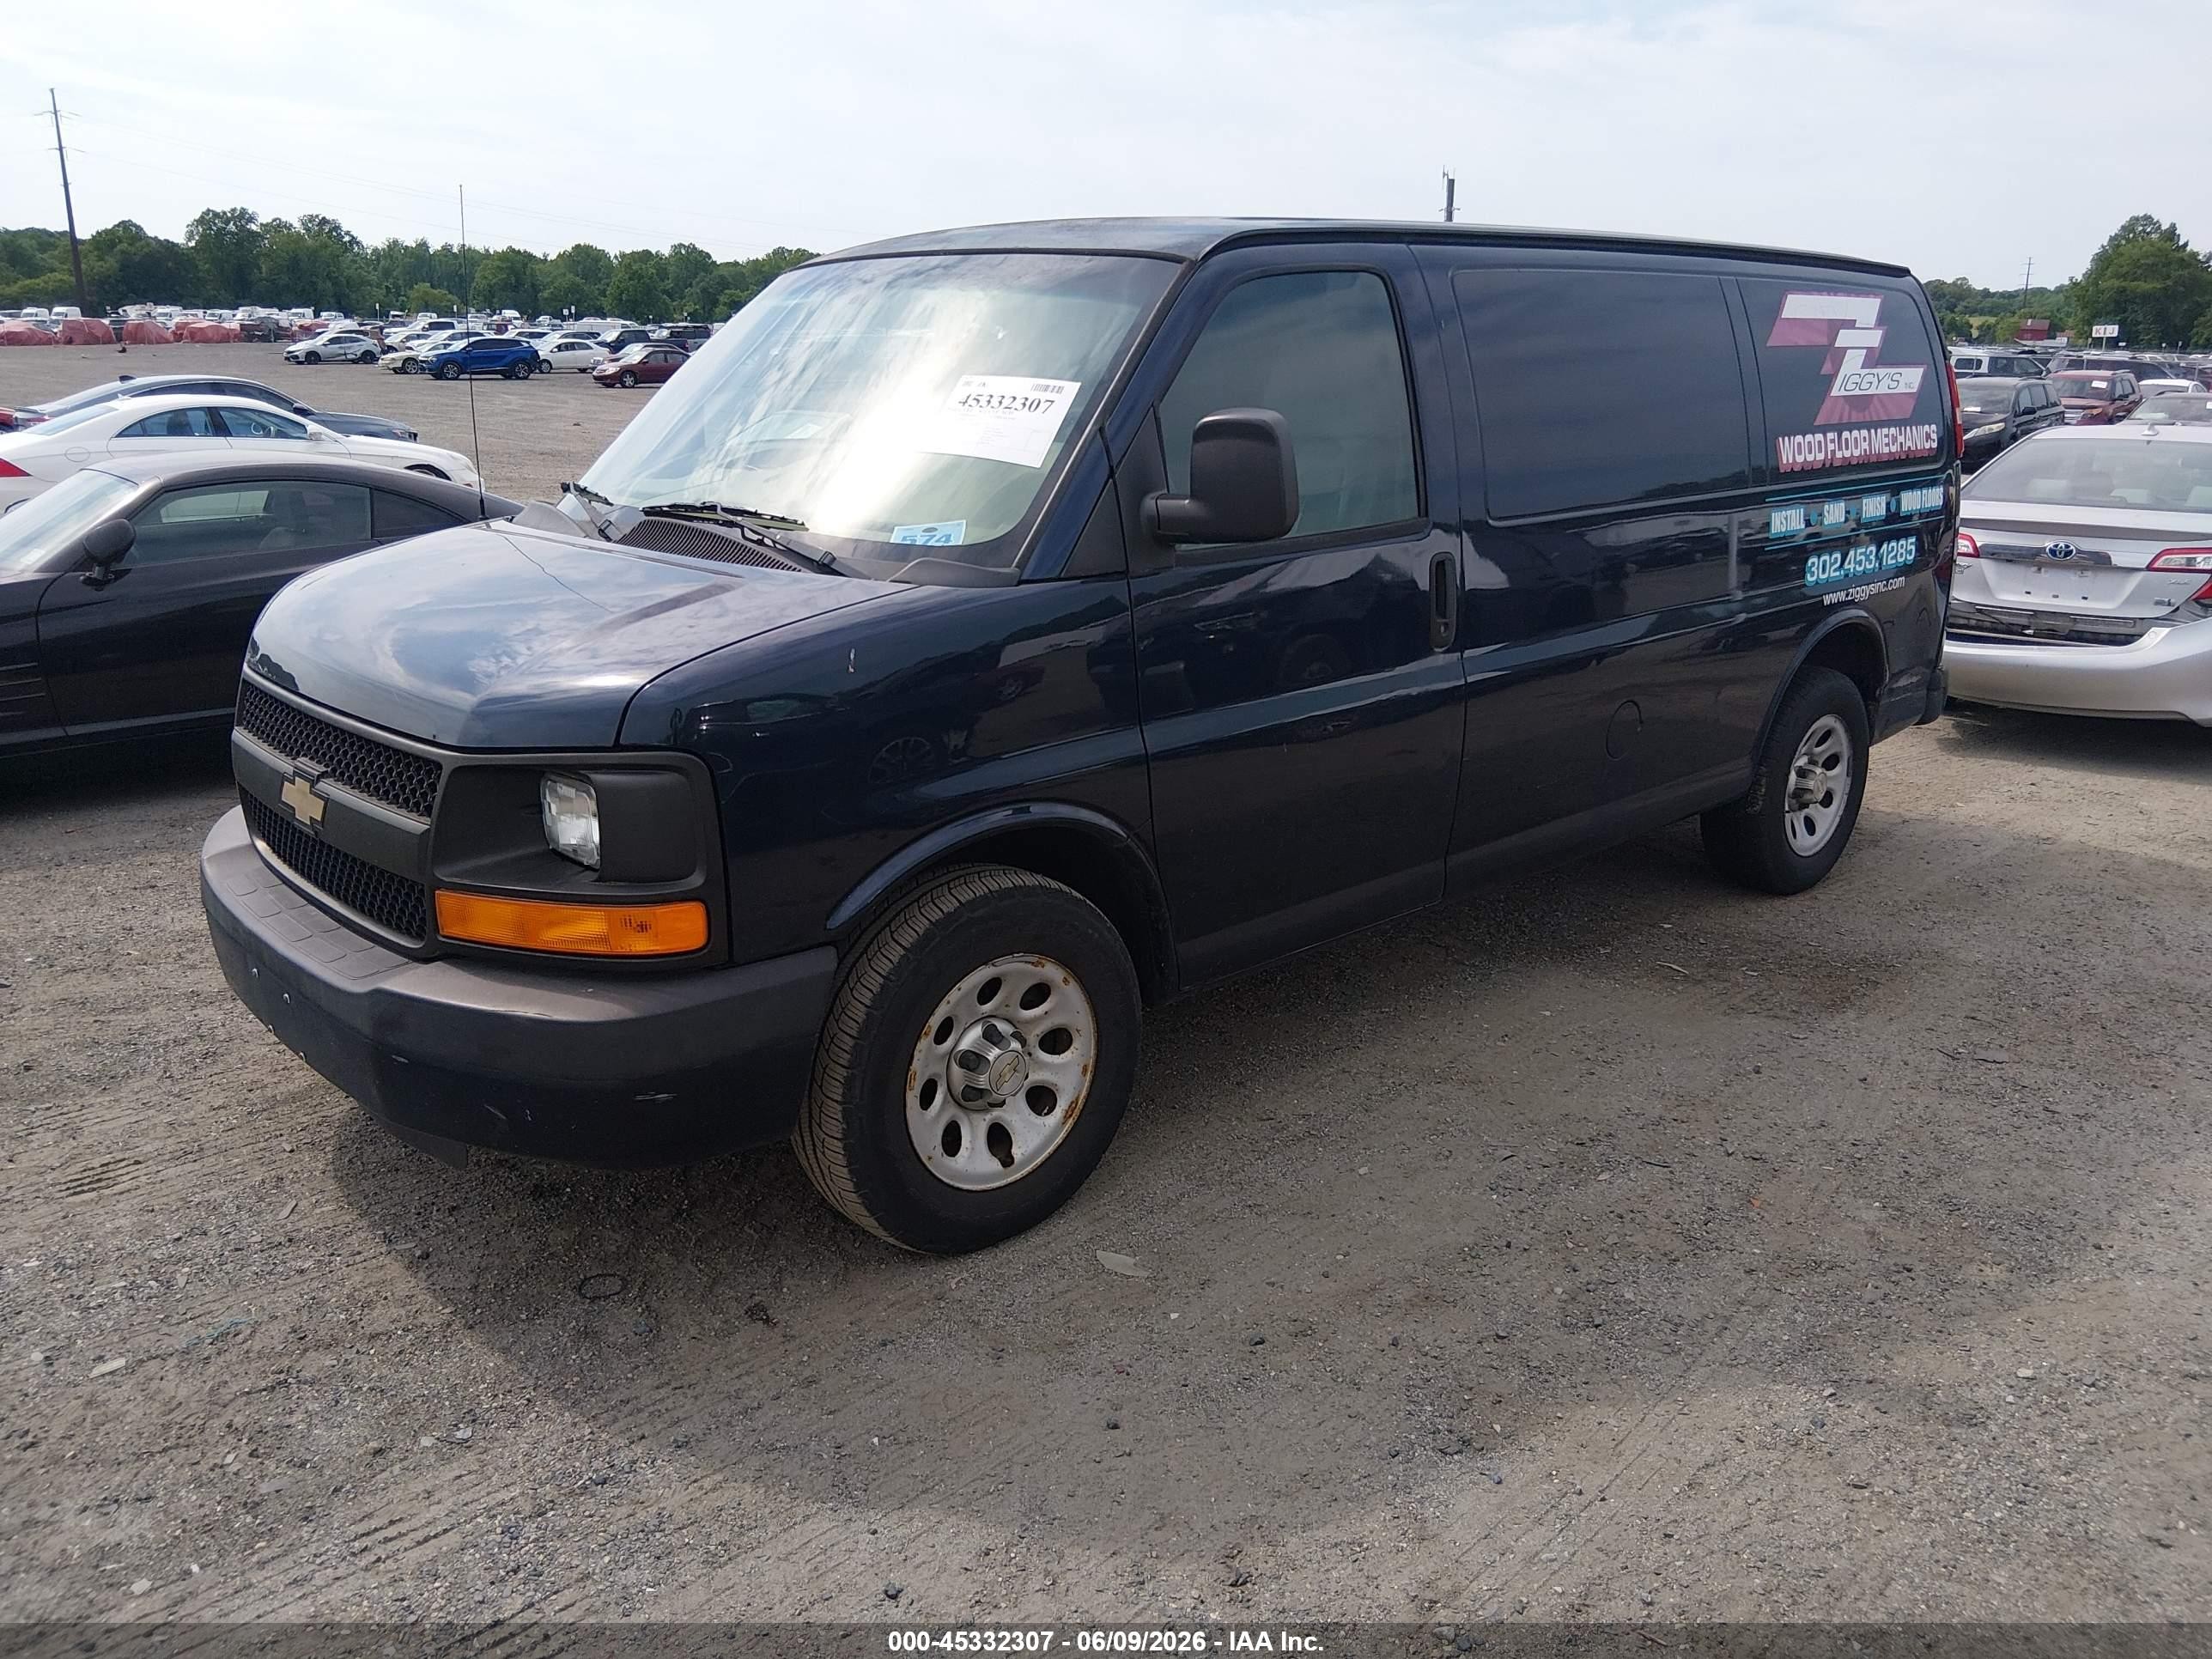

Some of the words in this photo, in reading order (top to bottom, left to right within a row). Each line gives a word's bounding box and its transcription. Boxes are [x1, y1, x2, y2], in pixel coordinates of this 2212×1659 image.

[957, 393, 1055, 415] 45332307
[1778, 433, 1825, 465] WOOD
[1826, 428, 1869, 460] FLOOR
[1870, 424, 1938, 455] MECHANICS
[1771, 507, 1805, 534] INSTALL
[1823, 501, 1845, 526] SAND
[1862, 494, 1887, 519] FINISH
[1901, 489, 1921, 512] WOOD
[1921, 485, 1944, 508] FLOORS
[1806, 536, 1917, 583] 302.453.1285
[1822, 576, 1905, 606] www.ziggysinc.com
